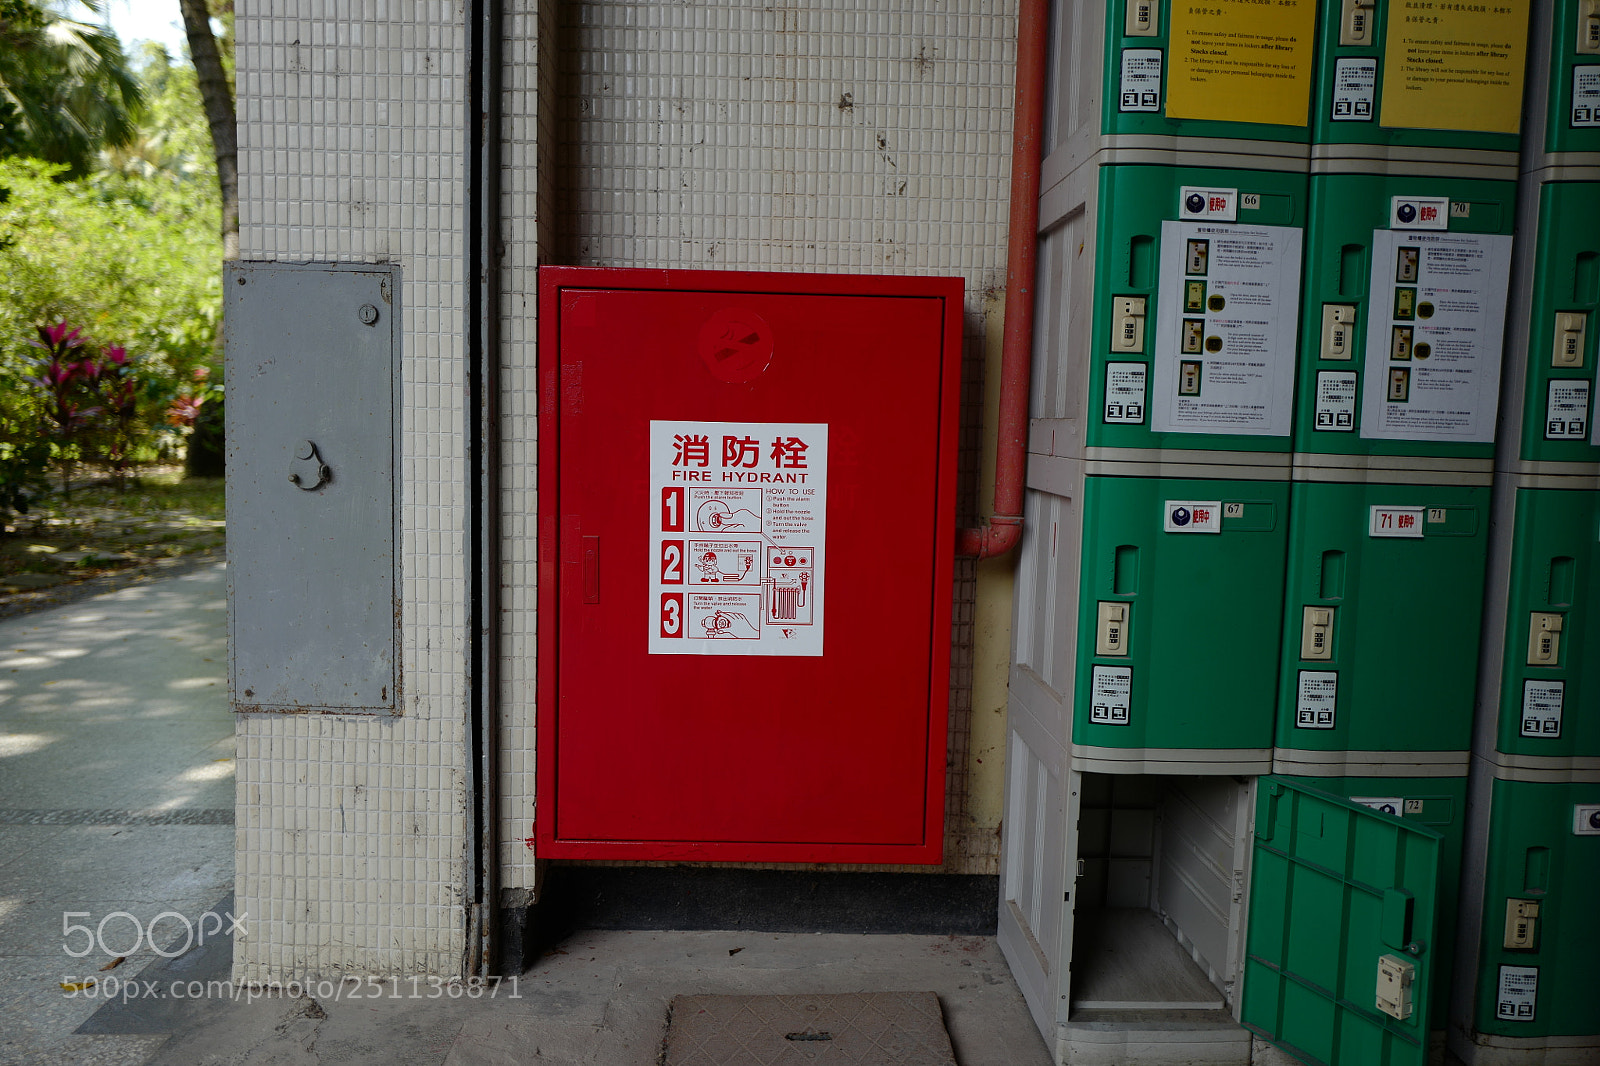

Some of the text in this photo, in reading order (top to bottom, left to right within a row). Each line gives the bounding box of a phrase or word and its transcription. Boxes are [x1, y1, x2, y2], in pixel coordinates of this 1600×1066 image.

[1209, 197, 1226, 212] 使用中
[1244, 195, 1256, 205] 66
[1420, 206, 1437, 221] 使用中
[1454, 203, 1465, 213] 70
[672, 434, 809, 469] 消防栓
[672, 471, 809, 483] FIRE HYDRANT
[666, 492, 677, 526] 1
[1193, 509, 1209, 523] 使用中
[1228, 504, 1240, 514] 67
[1432, 509, 1442, 519] 71
[1381, 514, 1415, 529] 71 使用中
[663, 545, 680, 580] 2
[663, 599, 680, 634] 3
[1408, 800, 1419, 810] 72
